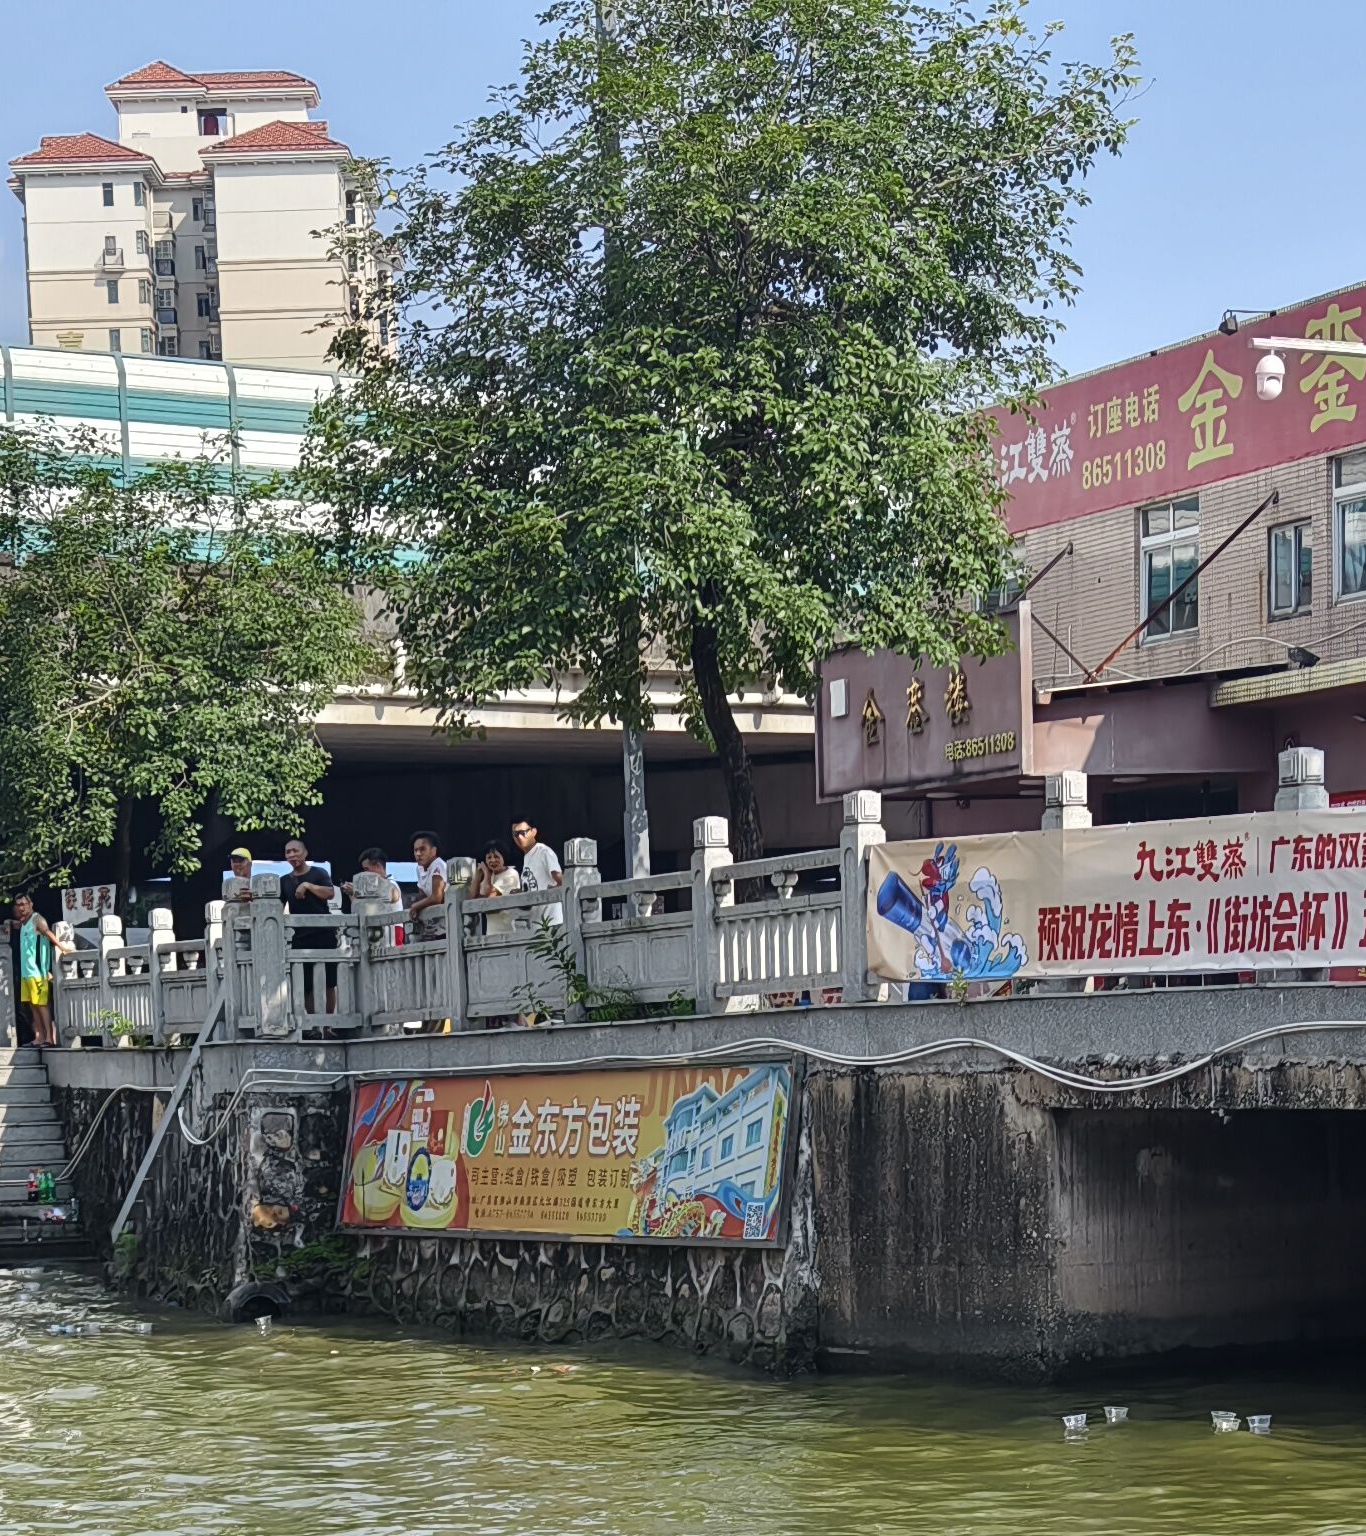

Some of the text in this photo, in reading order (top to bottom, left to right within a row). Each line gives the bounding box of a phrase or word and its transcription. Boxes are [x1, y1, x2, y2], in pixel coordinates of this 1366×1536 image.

[1088, 383, 1160, 440] 订座电话
[989, 420, 1075, 488] 江雙蒸
[1082, 439, 1167, 491] 86511308
[508, 1096, 642, 1160] 金东方包装
